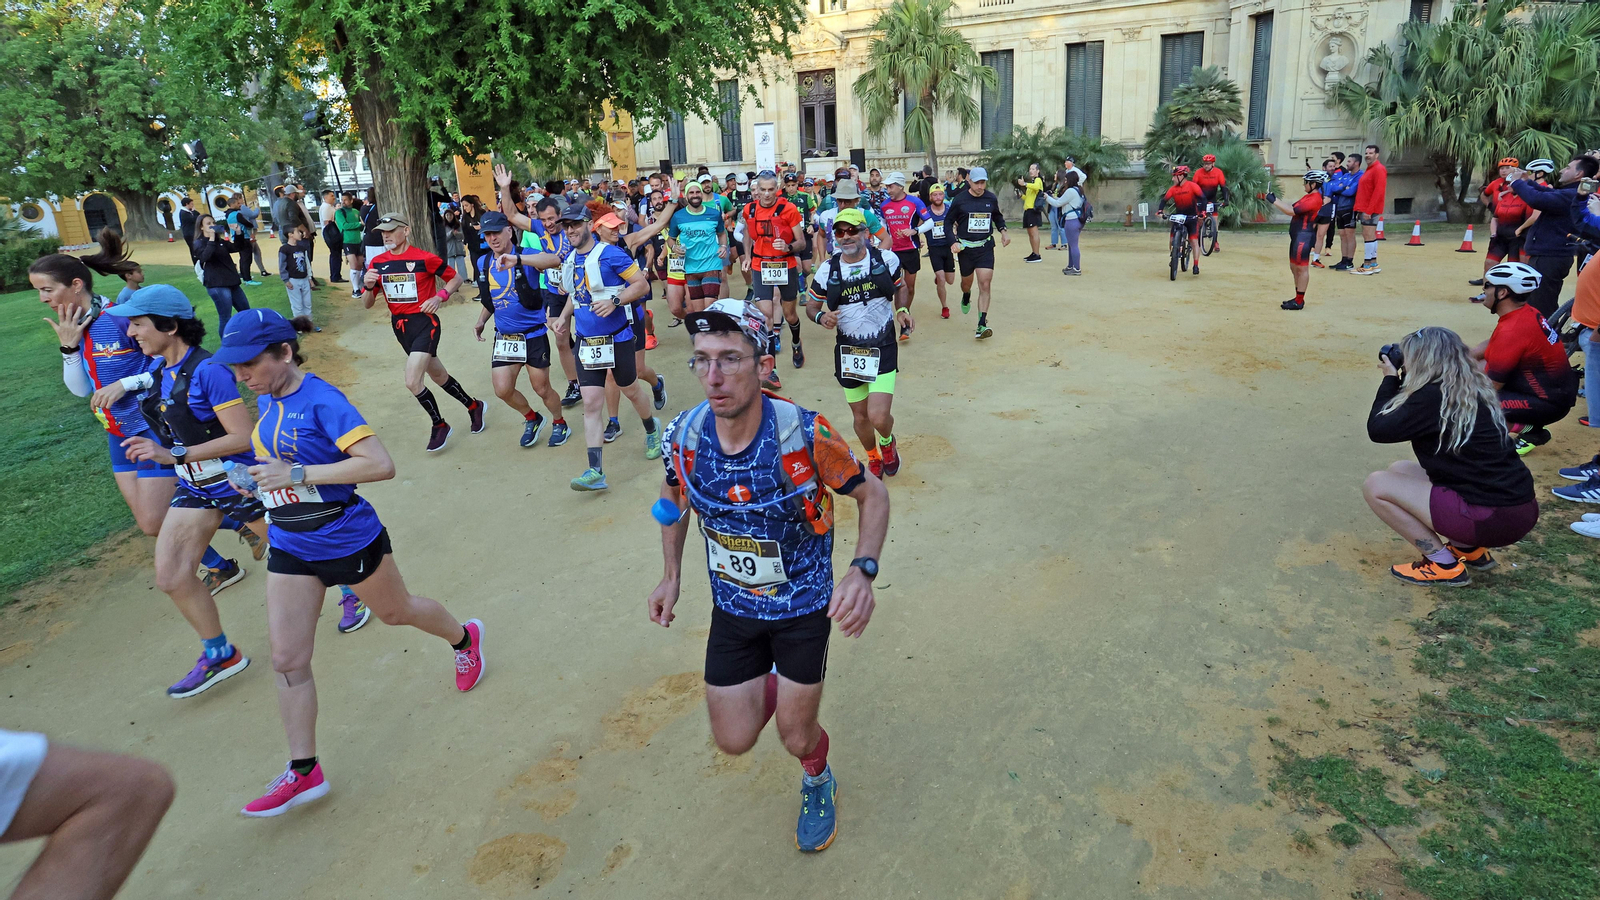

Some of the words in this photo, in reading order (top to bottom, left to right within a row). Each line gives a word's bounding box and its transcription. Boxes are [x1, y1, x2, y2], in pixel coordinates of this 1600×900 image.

[768, 269, 782, 278] 130
[393, 283, 405, 294] 17
[502, 341, 519, 353] 178
[590, 347, 602, 359] 35
[853, 357, 866, 370] 83
[269, 486, 300, 507] 116
[730, 555, 756, 577] 89
